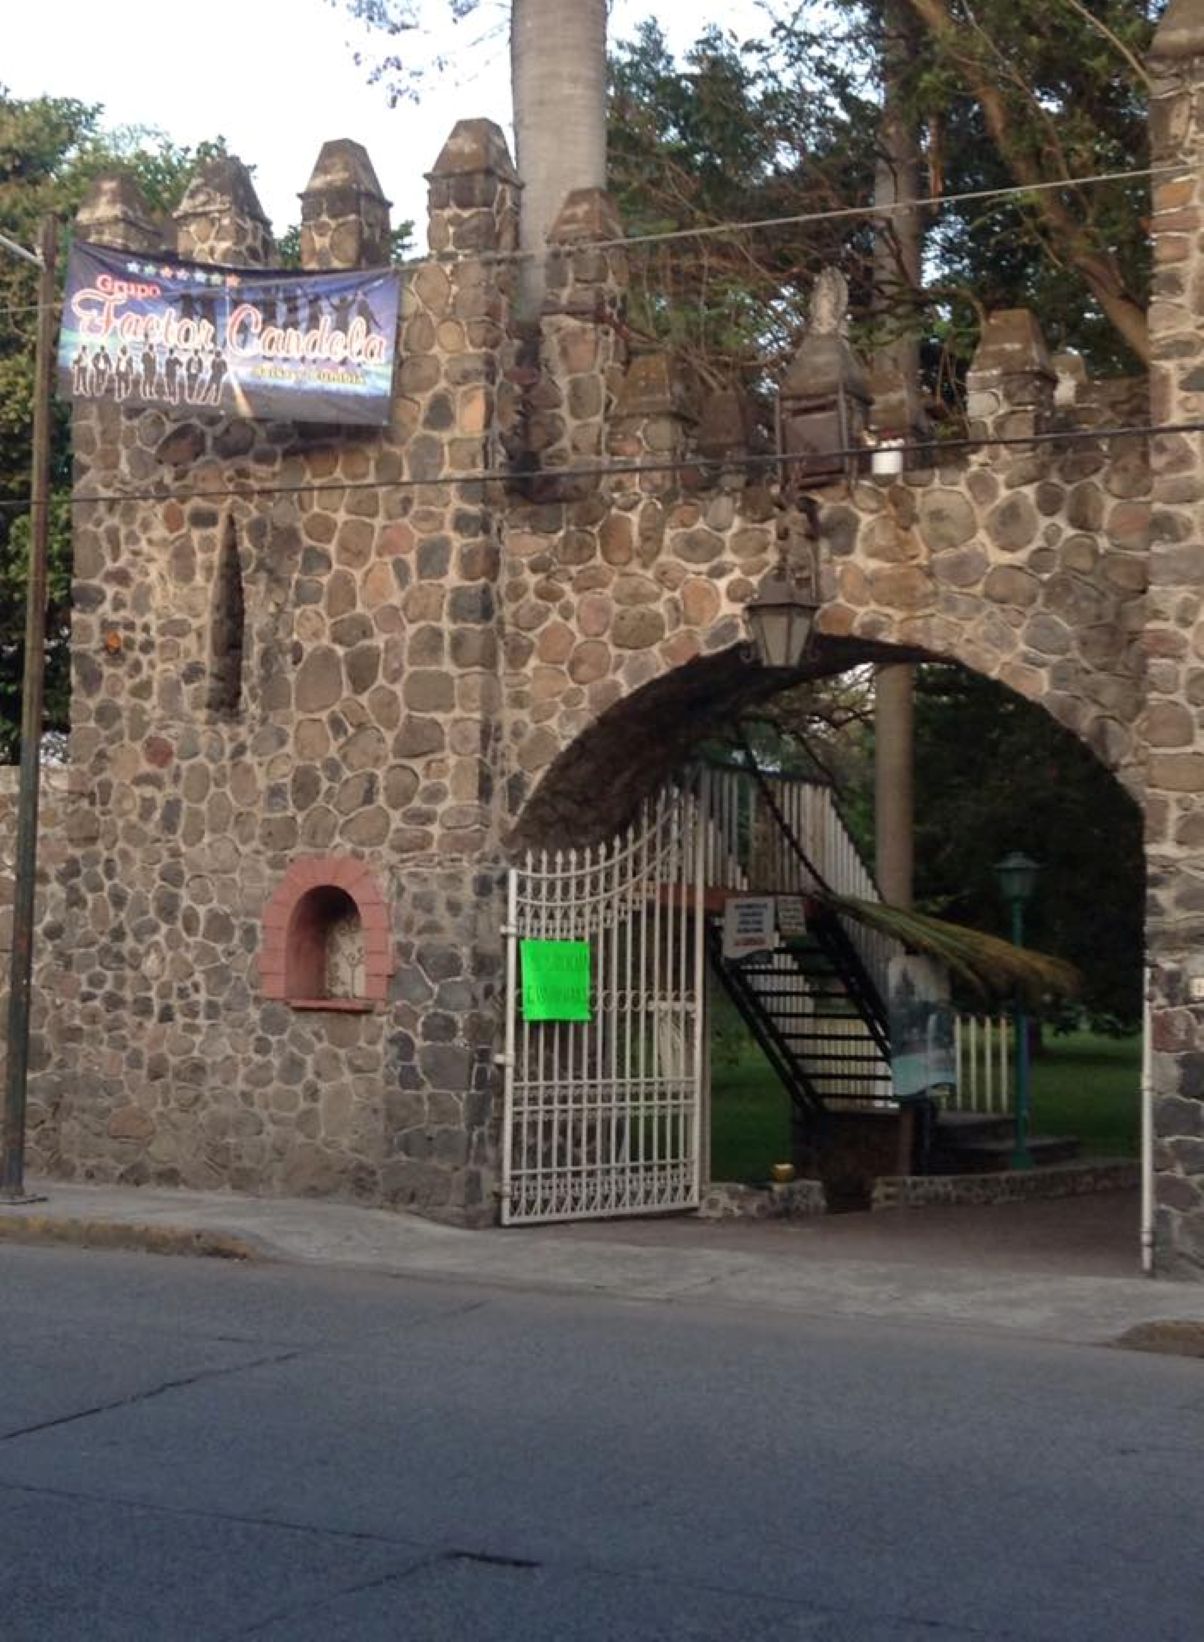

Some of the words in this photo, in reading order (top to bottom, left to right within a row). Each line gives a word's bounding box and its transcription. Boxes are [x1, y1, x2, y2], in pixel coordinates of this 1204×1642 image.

[96, 274, 161, 301] Grupo
[71, 288, 216, 350] Factor
[226, 303, 387, 364] Candela
